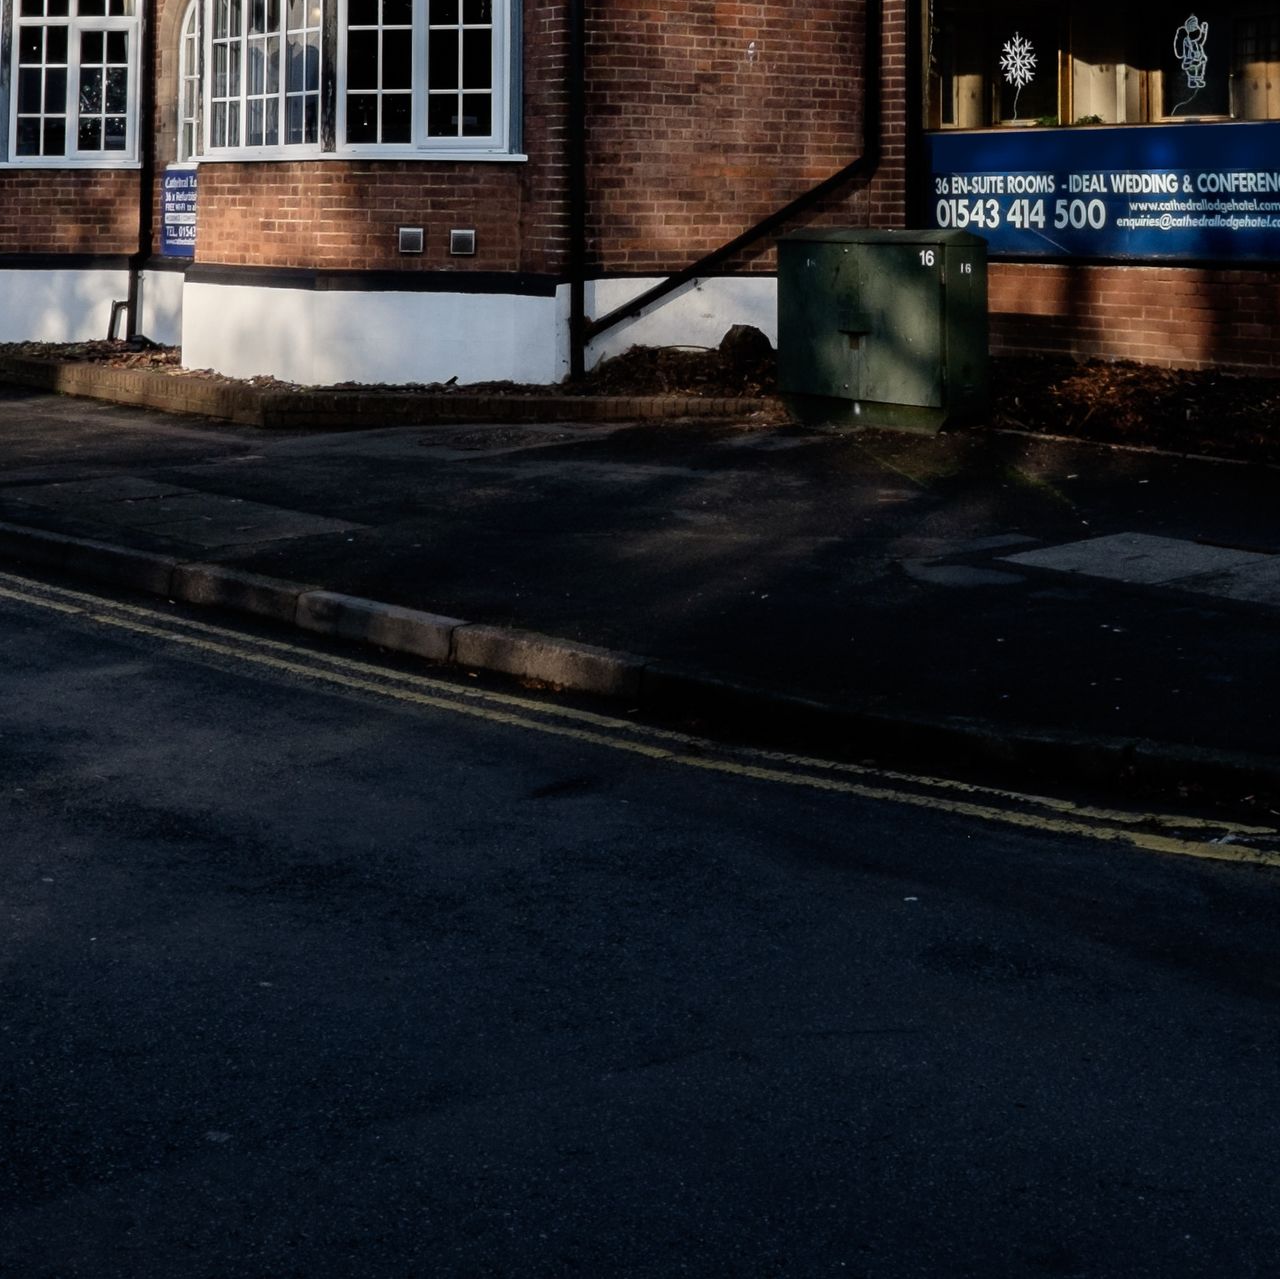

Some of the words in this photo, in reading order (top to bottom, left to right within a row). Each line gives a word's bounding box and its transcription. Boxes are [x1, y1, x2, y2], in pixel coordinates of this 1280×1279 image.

[935, 177, 949, 195] 36
[951, 175, 1004, 195] EN-SUITE
[1007, 175, 1055, 194] ROOMS
[1110, 173, 1179, 194] WEDDING
[1182, 174, 1194, 193] &
[936, 198, 1000, 229] 01543
[1006, 198, 1046, 229] 414
[1054, 198, 1107, 230] 500
[919, 249, 935, 267] 16
[960, 263, 972, 274] 16
